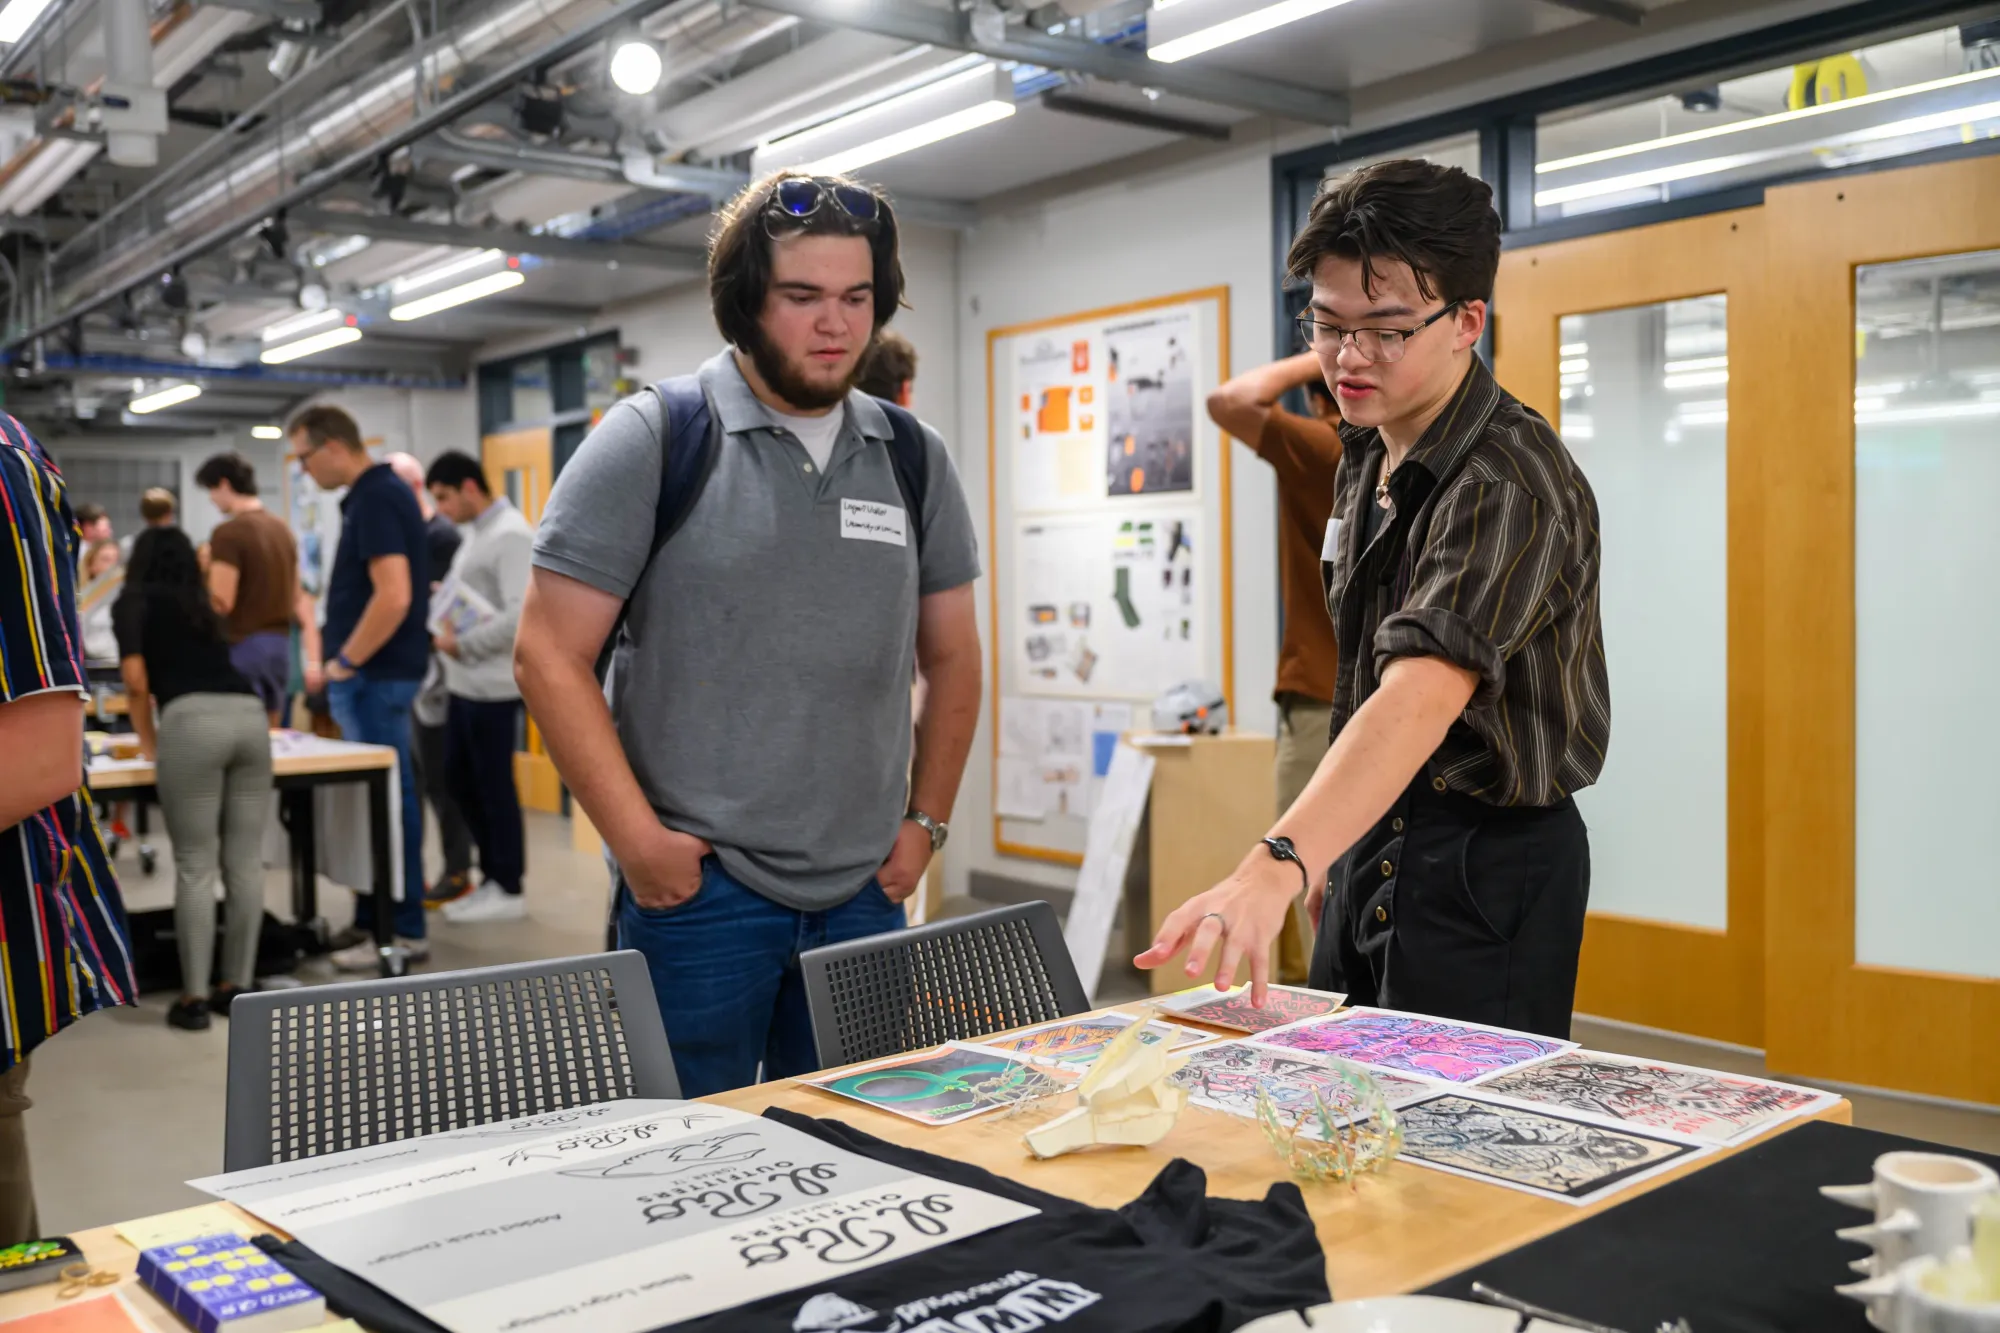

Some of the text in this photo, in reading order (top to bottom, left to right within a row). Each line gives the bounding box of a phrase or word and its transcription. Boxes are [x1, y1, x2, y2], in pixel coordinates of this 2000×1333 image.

[556, 1123, 658, 1152] el Rio
[636, 1161, 794, 1204] OUTFITTERS
[642, 1163, 837, 1225] el Rio
[729, 1193, 903, 1244] OUTFITTERS
[738, 1194, 954, 1268] el Rio
